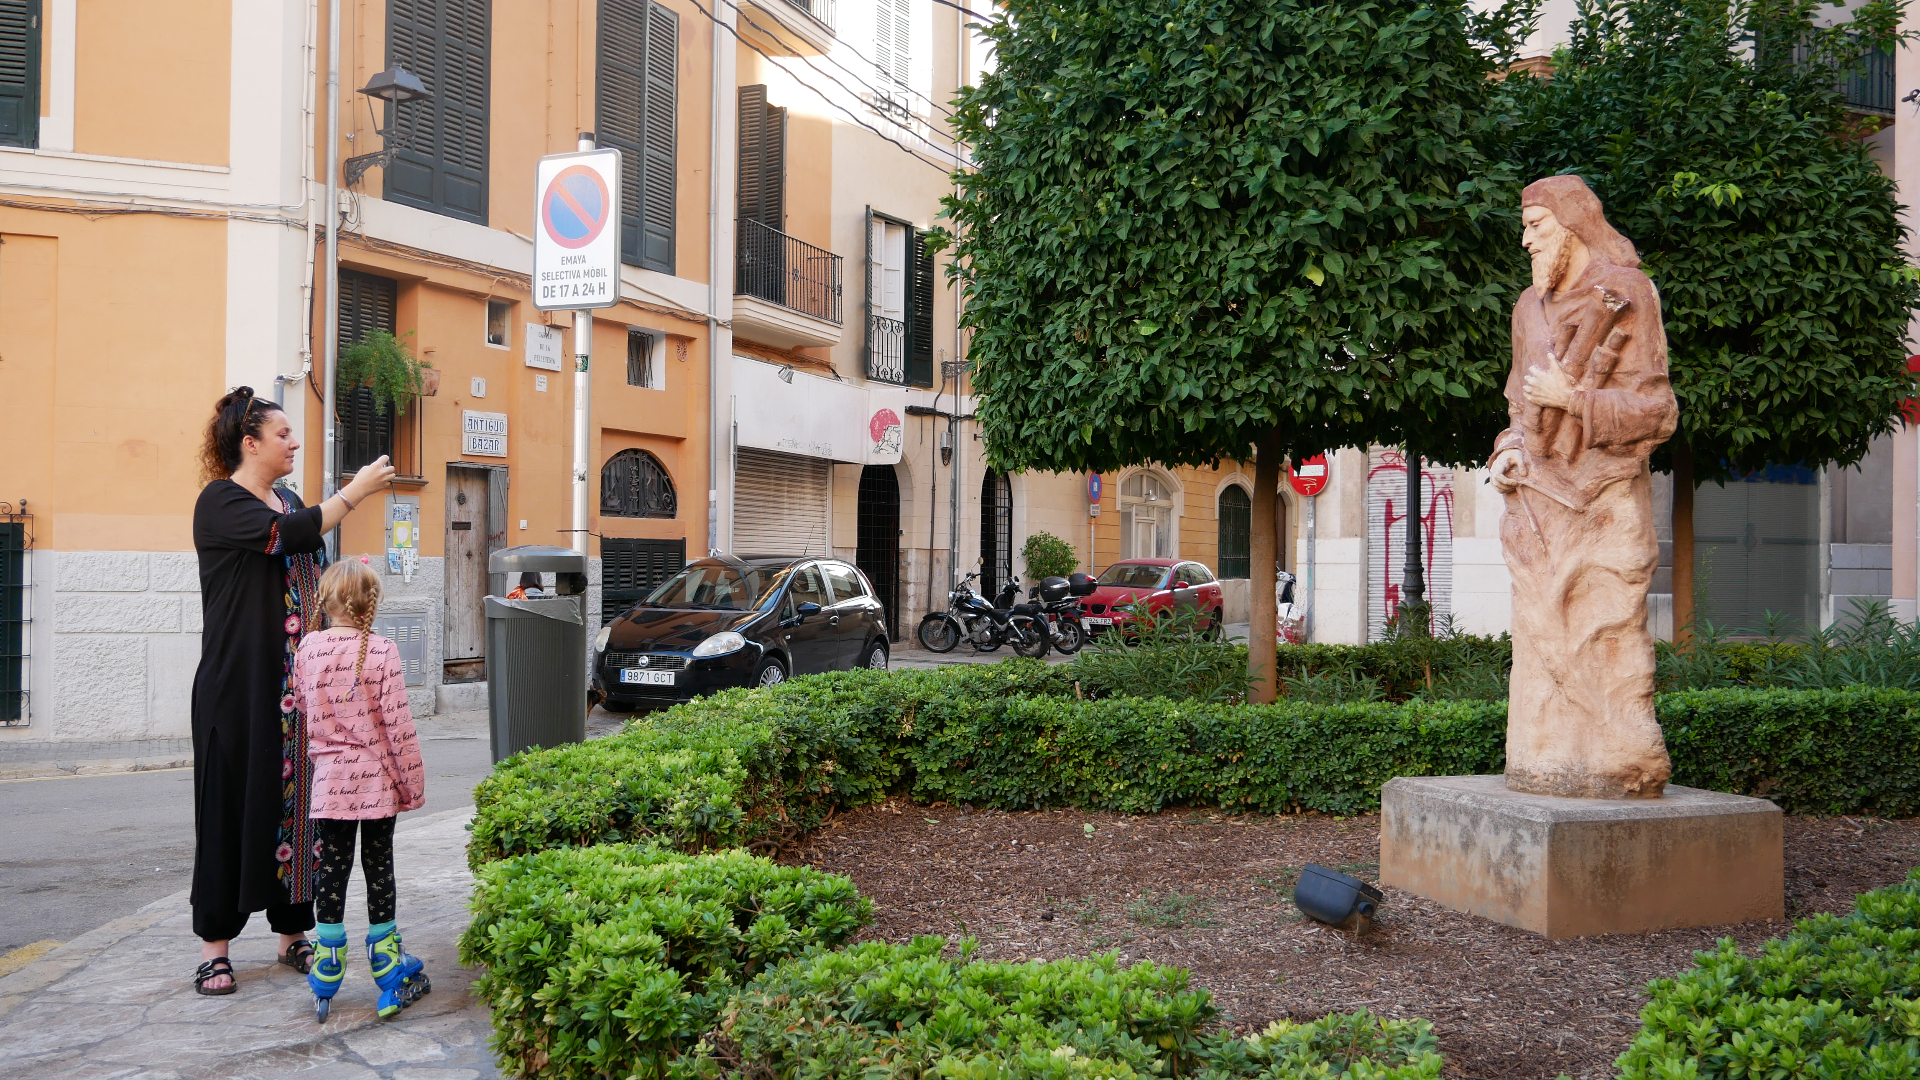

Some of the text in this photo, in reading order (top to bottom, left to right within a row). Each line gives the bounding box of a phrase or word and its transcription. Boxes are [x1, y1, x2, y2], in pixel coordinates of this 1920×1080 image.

[561, 255, 587, 266] EMAYA
[541, 269, 581, 281] SELECTIVA
[542, 281, 606, 298] DE 17 A 24 H
[467, 418, 505, 433] ANTIGUO
[472, 437, 500, 451] BAZAR
[338, 632, 360, 642] kind
[317, 646, 336, 658] kind
[325, 661, 354, 674] be kind
[316, 677, 334, 689] kind
[627, 671, 673, 683] 9871 GCT
[402, 730, 417, 742] kind
[408, 759, 423, 771] kind
[349, 771, 360, 782] be
[361, 767, 382, 780] kind
[328, 784, 360, 796] be kind
[348, 802, 358, 812] be
[360, 798, 381, 811] kind
